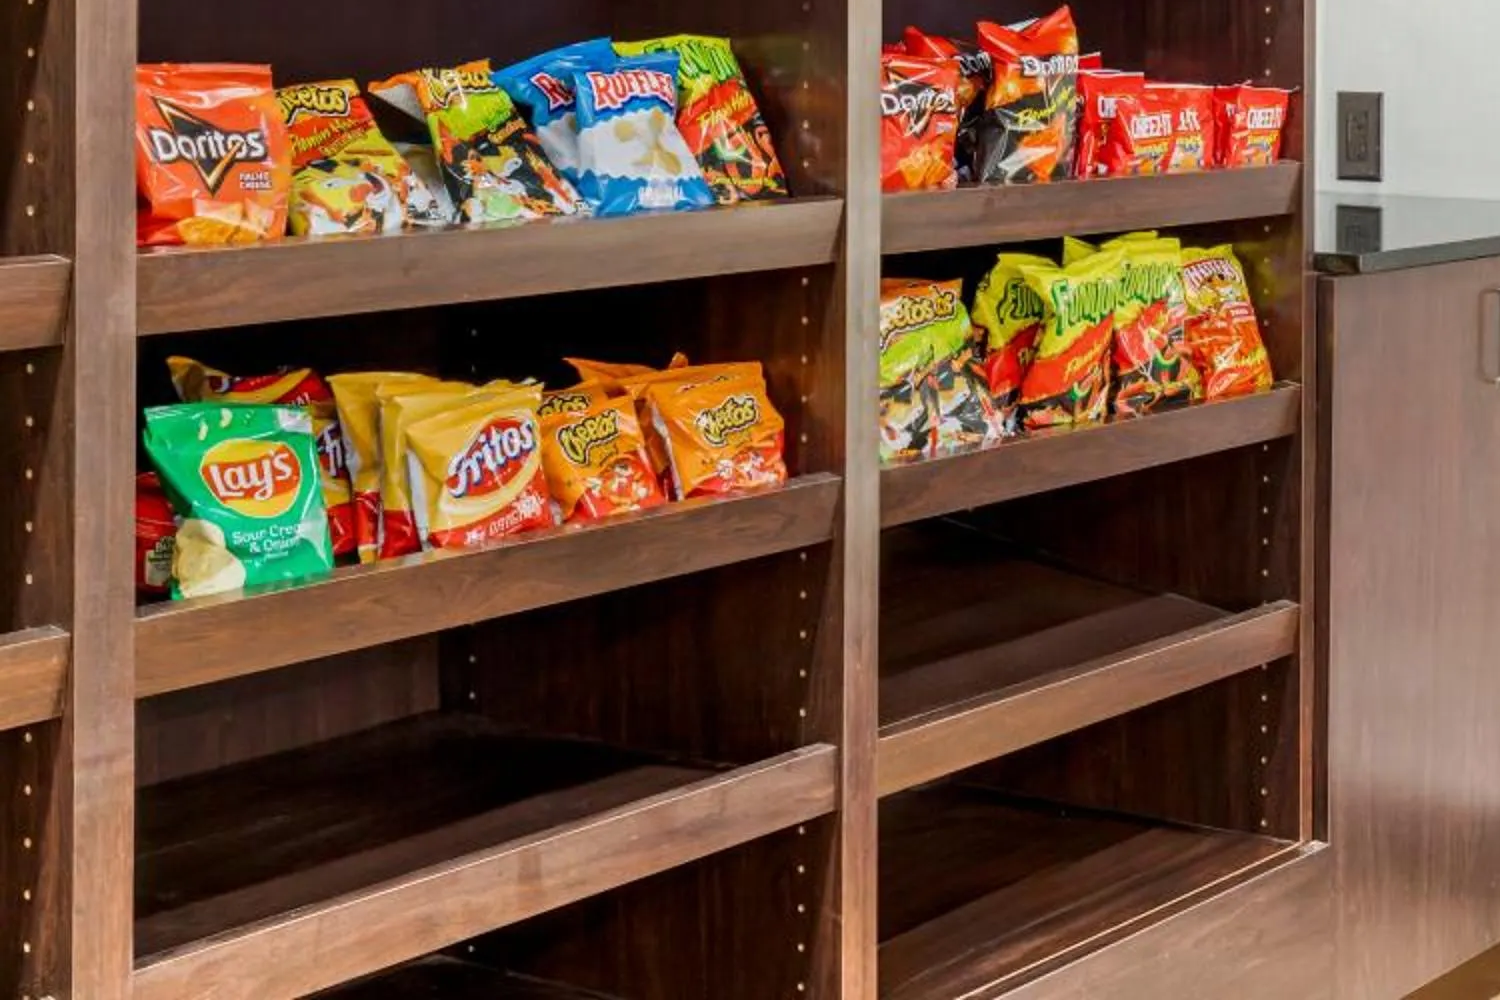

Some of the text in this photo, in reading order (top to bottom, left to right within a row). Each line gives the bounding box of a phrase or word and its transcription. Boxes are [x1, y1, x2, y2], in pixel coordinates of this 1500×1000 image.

[151, 129, 266, 161] Doritos
[209, 450, 293, 501] Lay's
[447, 420, 536, 498] Fritos
